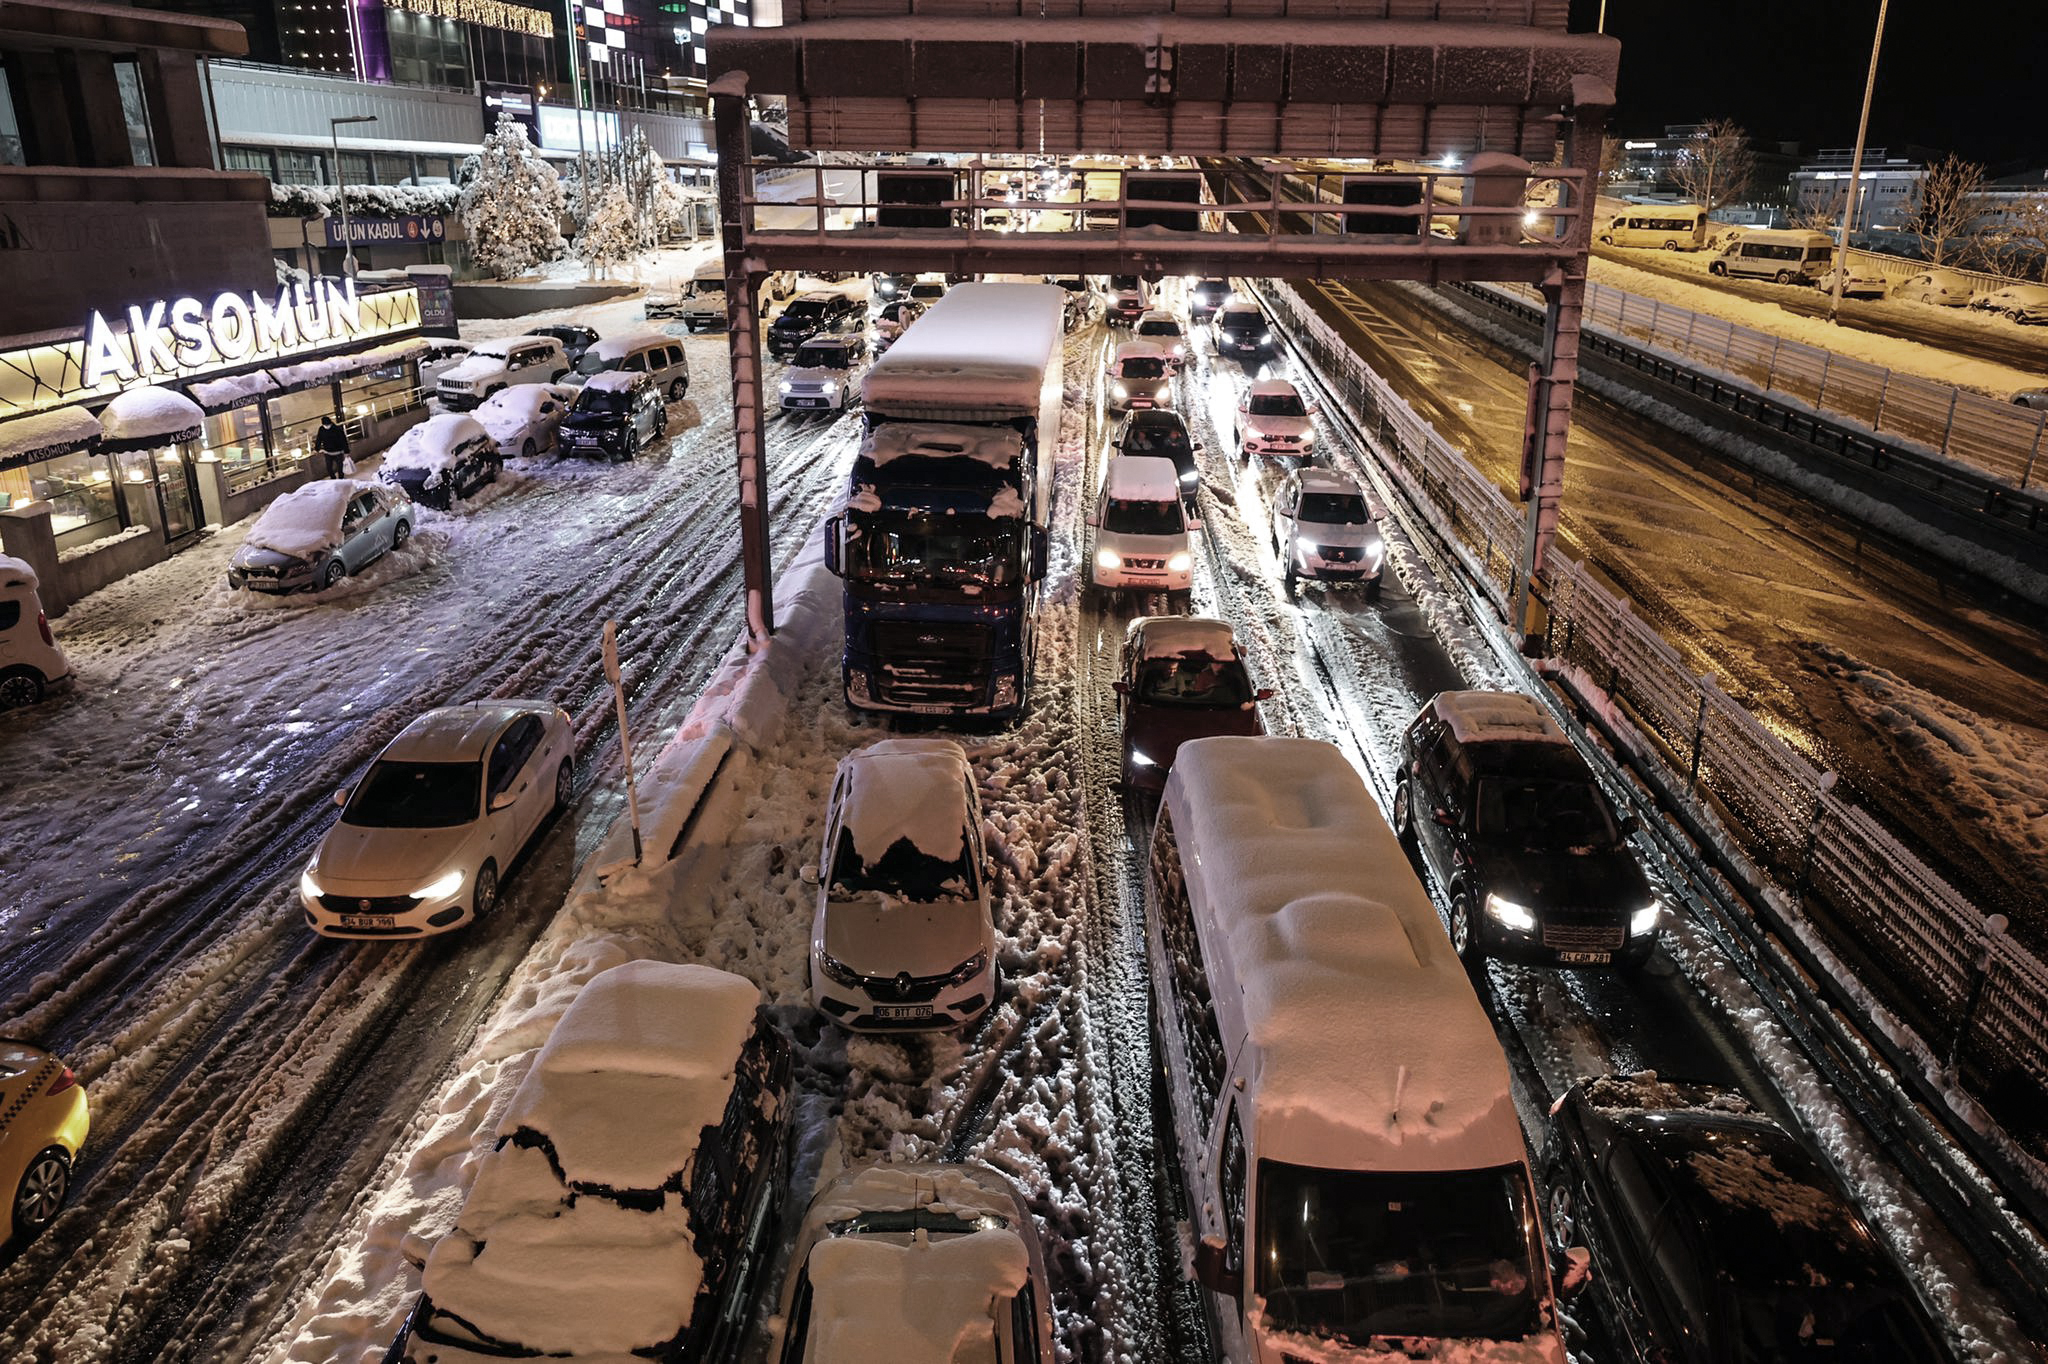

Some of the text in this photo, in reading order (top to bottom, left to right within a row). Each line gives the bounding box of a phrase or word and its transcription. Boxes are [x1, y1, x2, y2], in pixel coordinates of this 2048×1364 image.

[333, 220, 366, 242] ÜRÜN
[367, 222, 404, 240] KABUL
[424, 308, 446, 317] OLDU
[81, 277, 360, 389] AKSOMUN
[169, 429, 201, 444] AKSOMU
[27, 442, 72, 463] AKSOMUN
[1561, 952, 1571, 961] 34
[880, 1007, 931, 1017] 06 BTT 076
